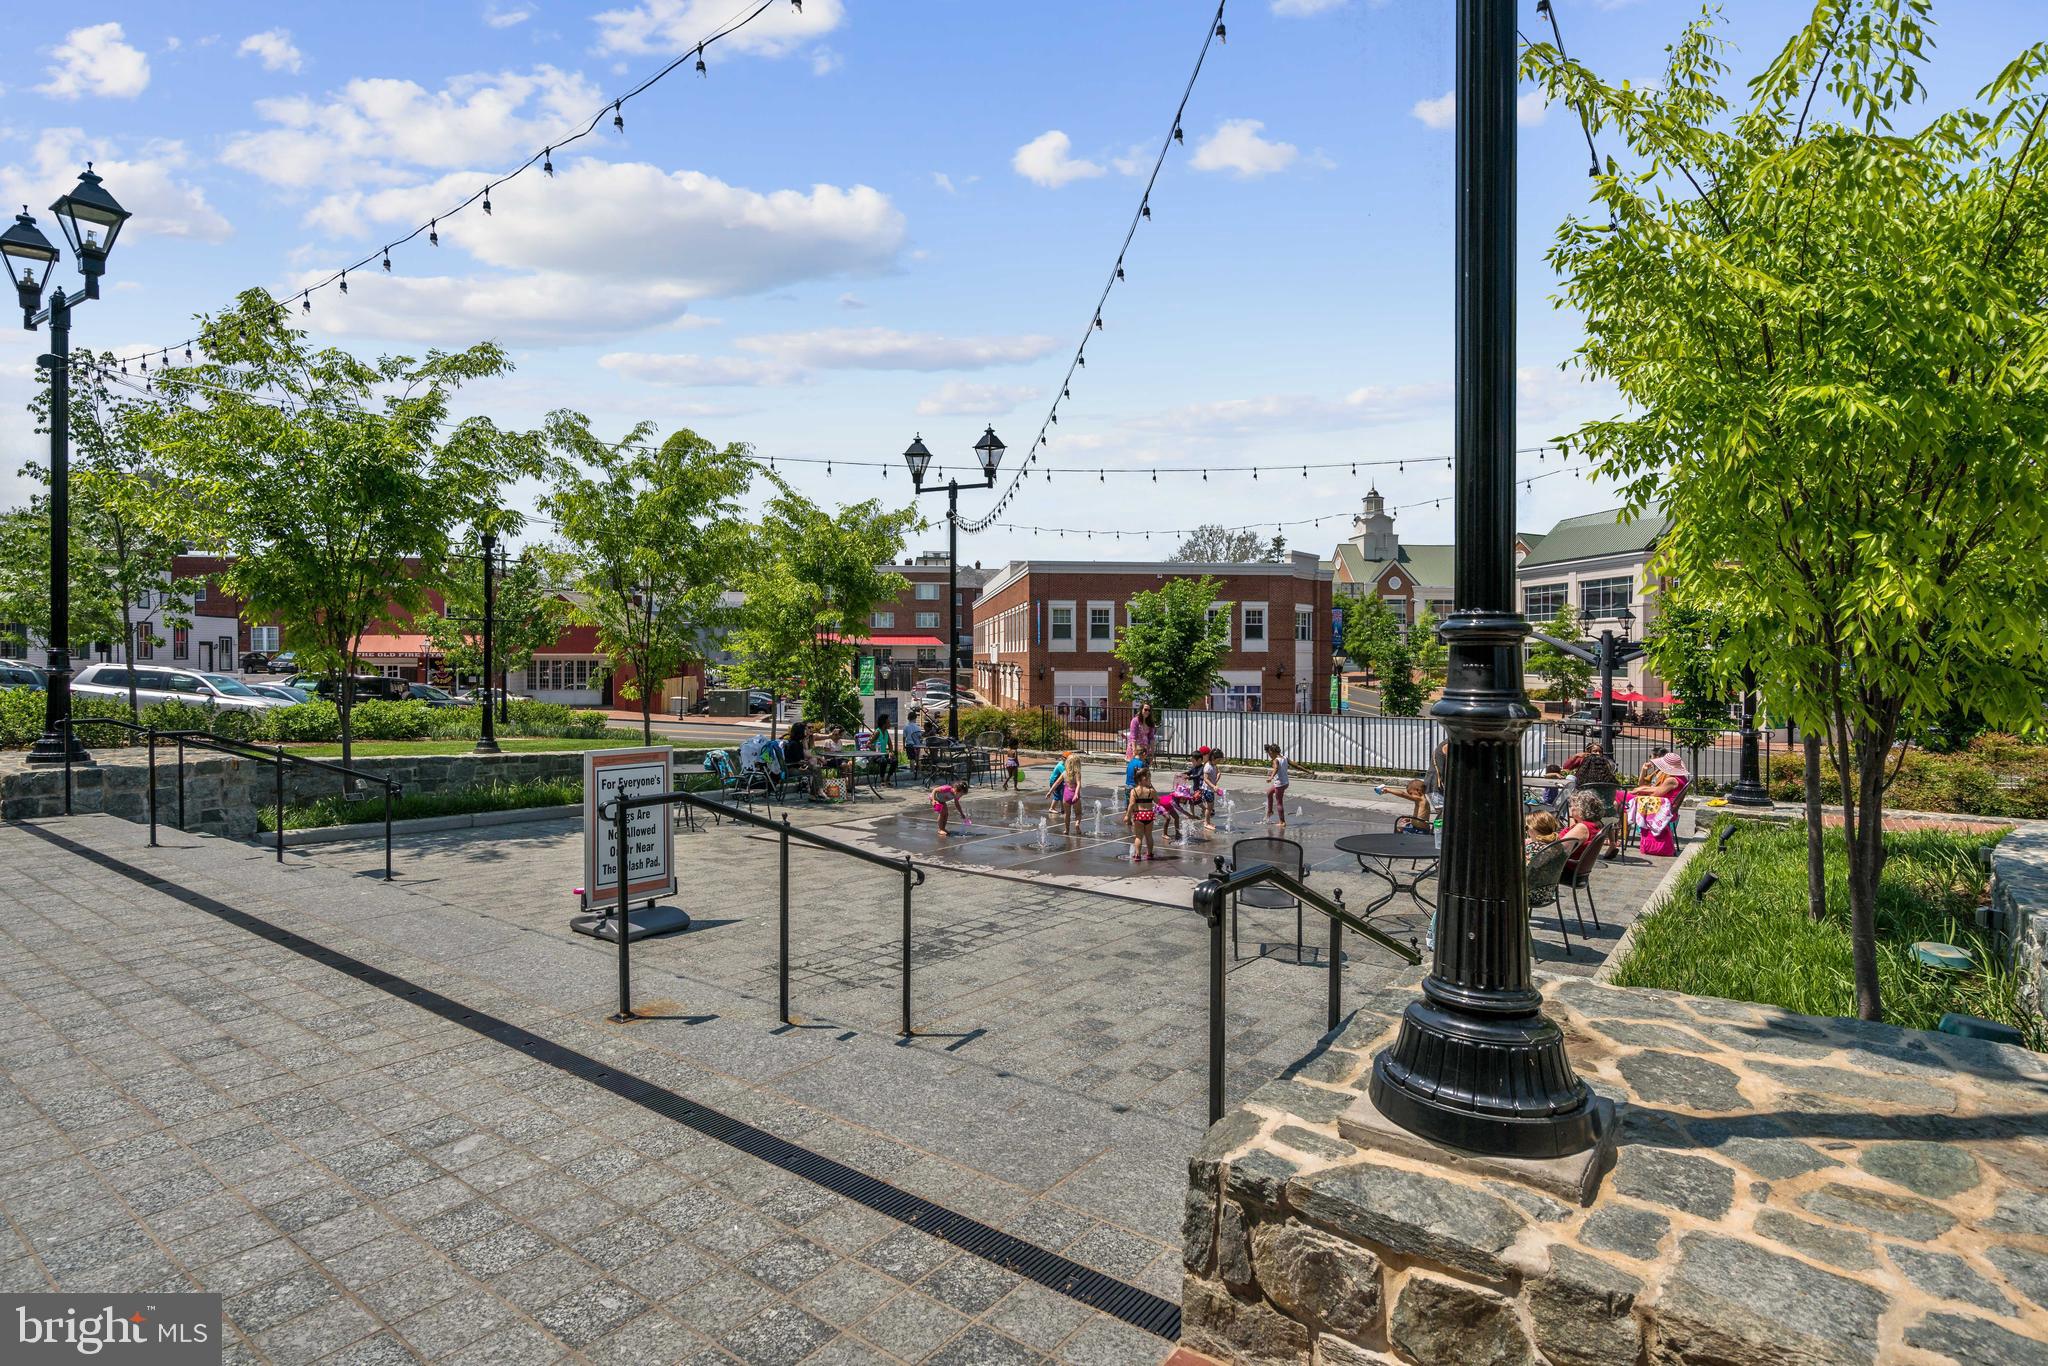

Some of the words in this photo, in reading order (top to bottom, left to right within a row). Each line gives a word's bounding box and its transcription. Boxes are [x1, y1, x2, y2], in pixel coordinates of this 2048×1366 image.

[601, 778, 617, 790] For
[618, 774, 661, 790] Everyone's
[636, 808, 651, 820] Are
[636, 842, 655, 854] Near
[602, 863, 617, 875] The
[645, 855, 661, 868] Pad.
